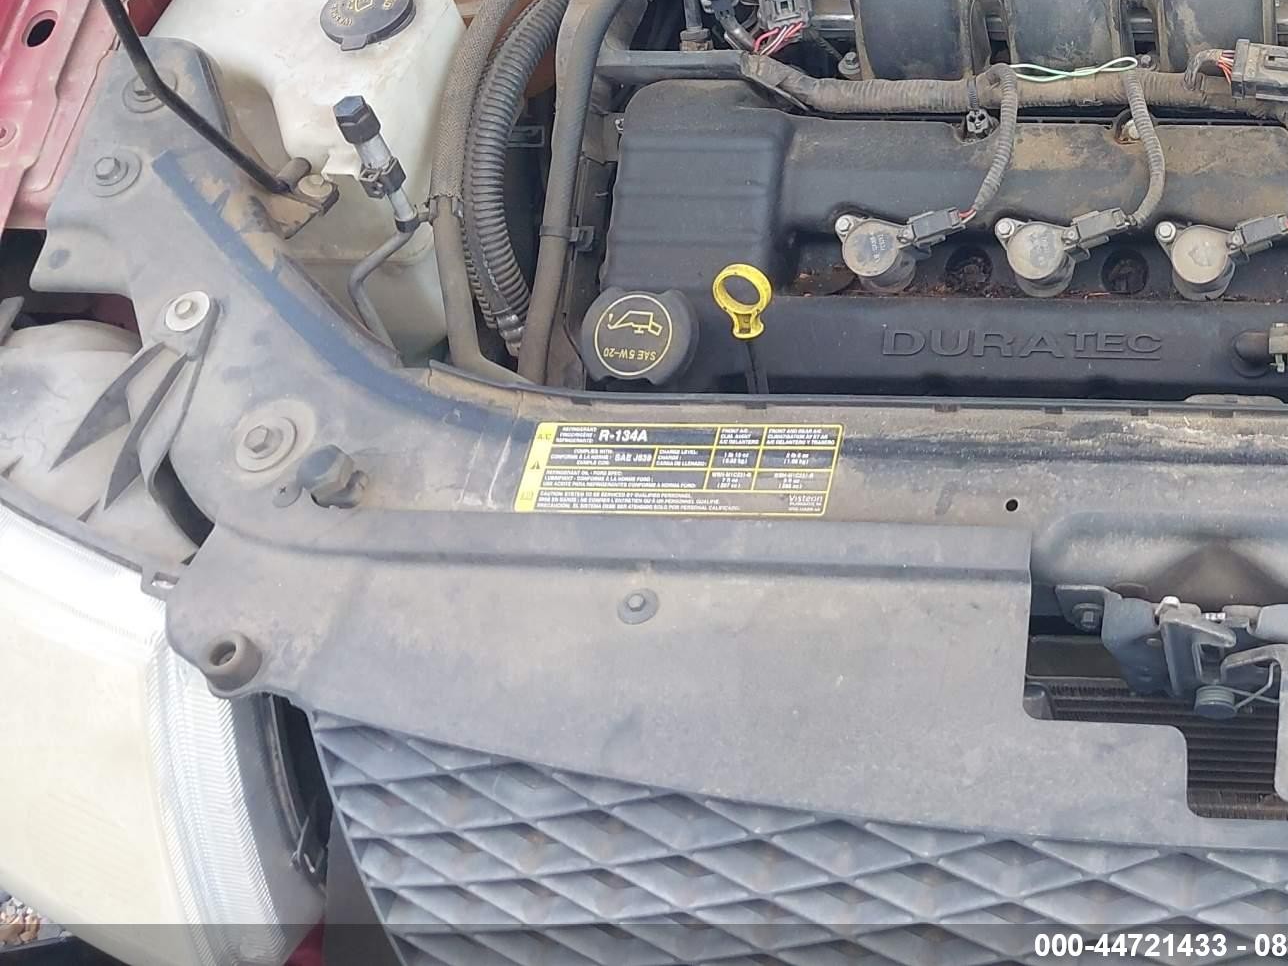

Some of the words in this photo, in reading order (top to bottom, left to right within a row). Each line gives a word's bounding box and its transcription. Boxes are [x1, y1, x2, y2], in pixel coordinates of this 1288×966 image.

[882, 329, 1163, 359] DURATEC
[602, 347, 636, 360] 5W-20
[637, 349, 657, 361] SAE
[598, 429, 648, 442] R-134A
[789, 494, 823, 502] Visteon
